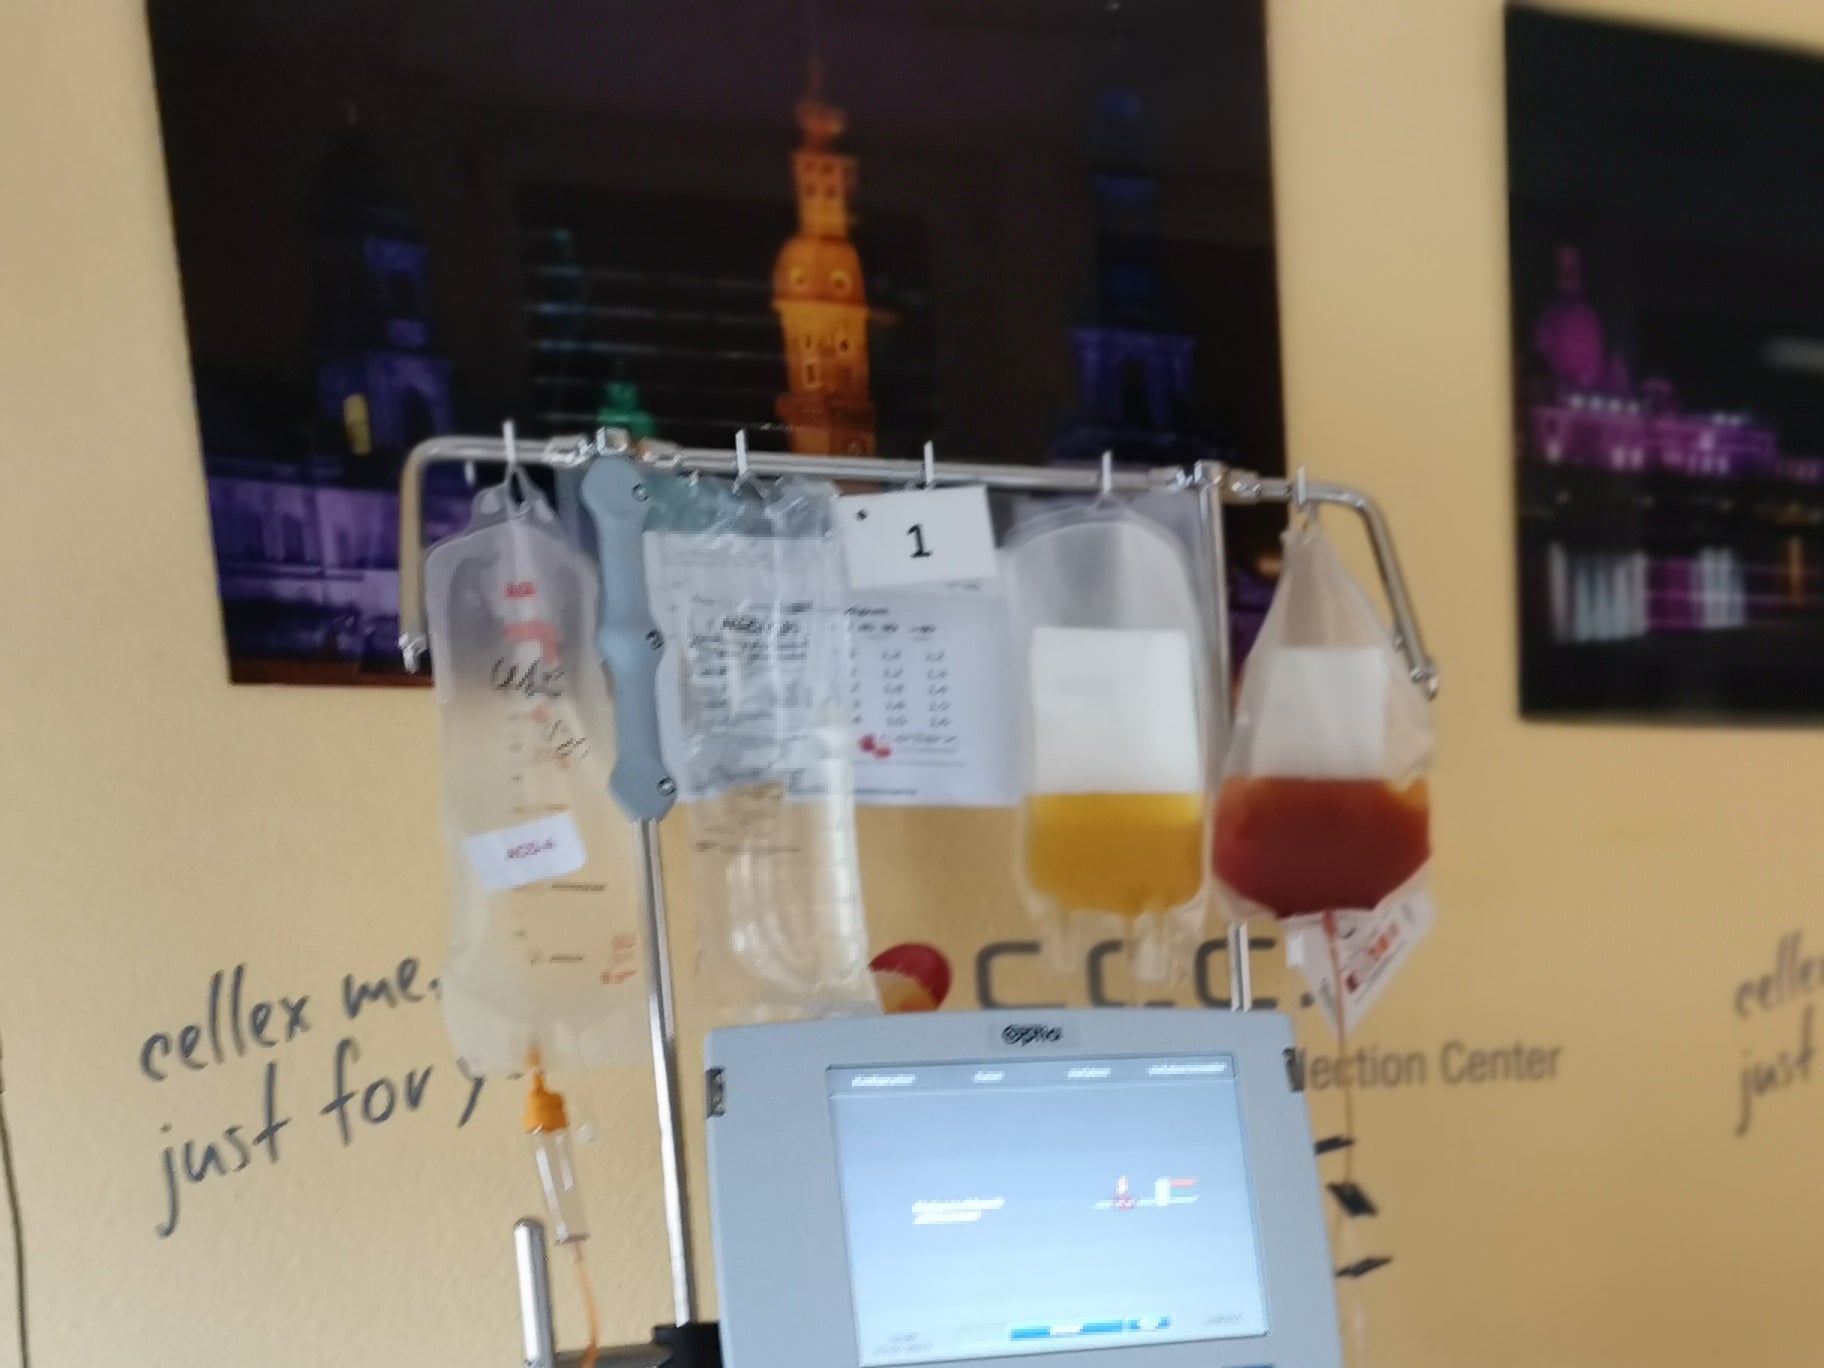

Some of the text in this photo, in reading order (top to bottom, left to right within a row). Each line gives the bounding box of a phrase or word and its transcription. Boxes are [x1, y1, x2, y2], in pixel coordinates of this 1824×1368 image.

[907, 524, 933, 559] 1
[140, 956, 441, 1082] cellex me.
[1440, 1040, 1562, 1085] Center
[156, 1059, 291, 1239] just
[320, 1036, 434, 1148] for
